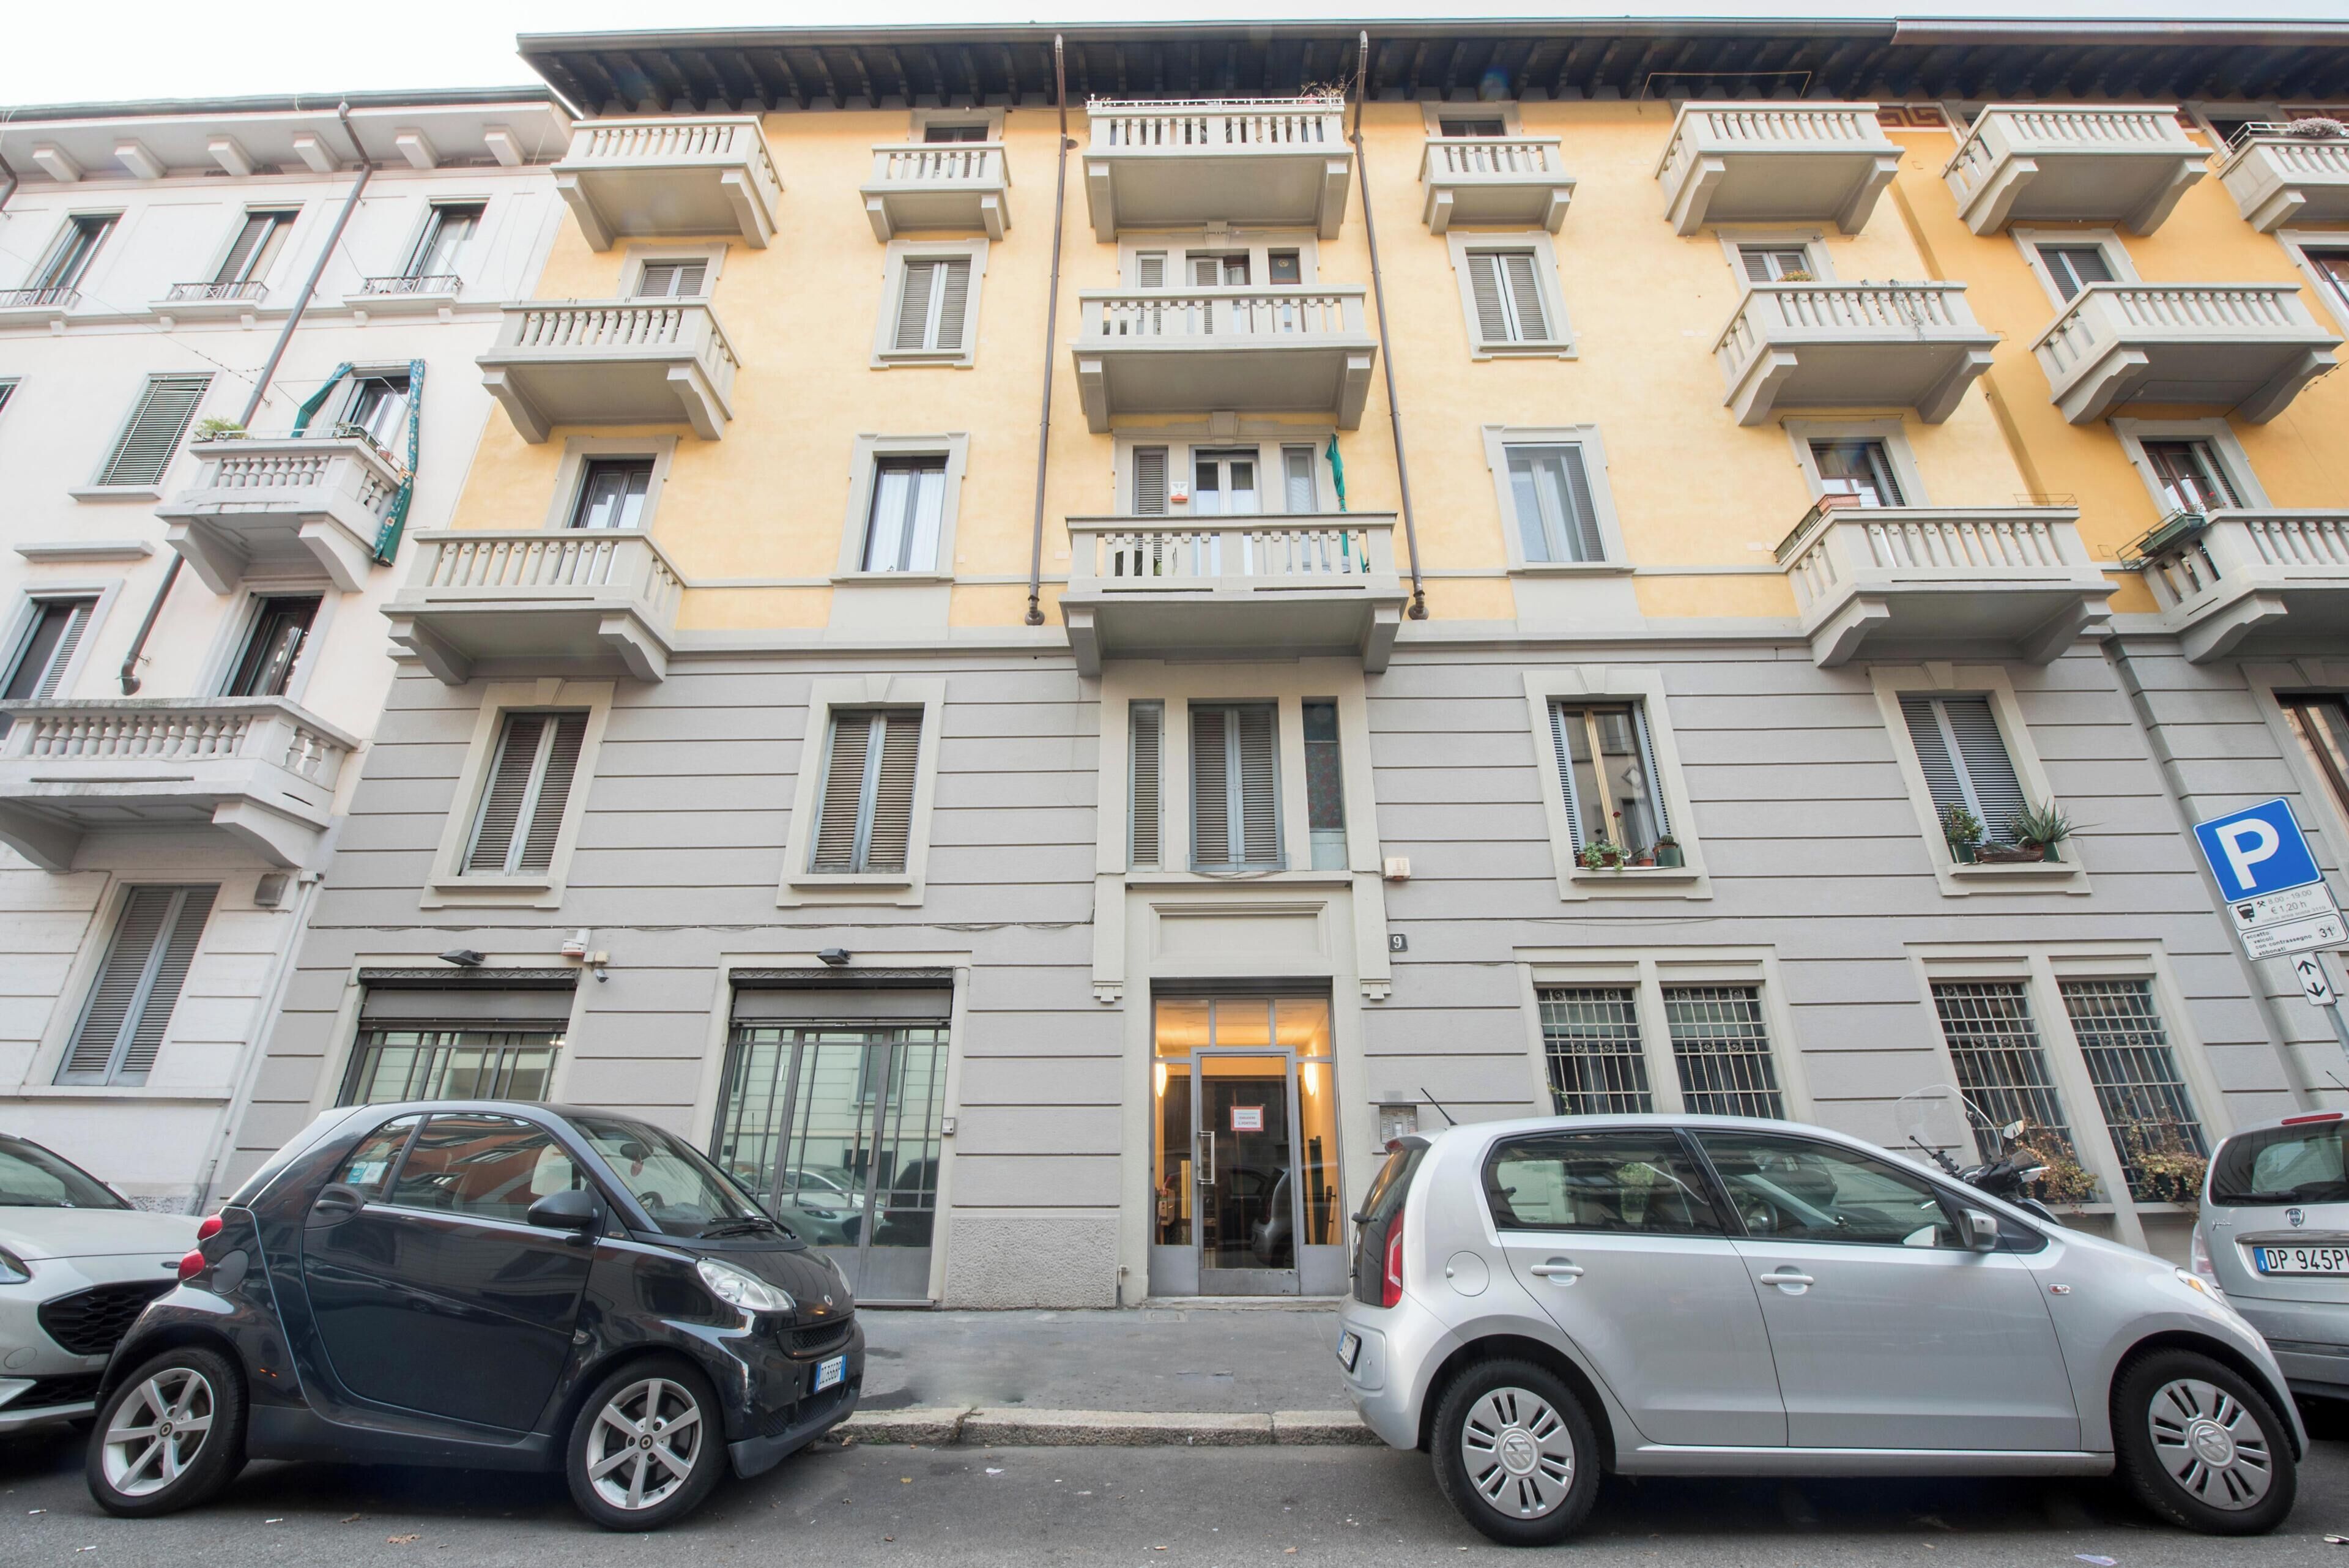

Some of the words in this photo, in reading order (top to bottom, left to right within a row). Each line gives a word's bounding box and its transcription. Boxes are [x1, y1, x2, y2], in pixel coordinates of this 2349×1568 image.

[2215, 818, 2280, 890] P
[2268, 896, 2284, 904] 8.00
[2291, 890, 2312, 899] 19.00
[2319, 927, 2335, 938] 31
[1393, 935, 1402, 949] 9
[2254, 935, 2274, 944] veicoli
[2269, 934, 2312, 946] contrassegno
[2258, 946, 2286, 956] abbonati
